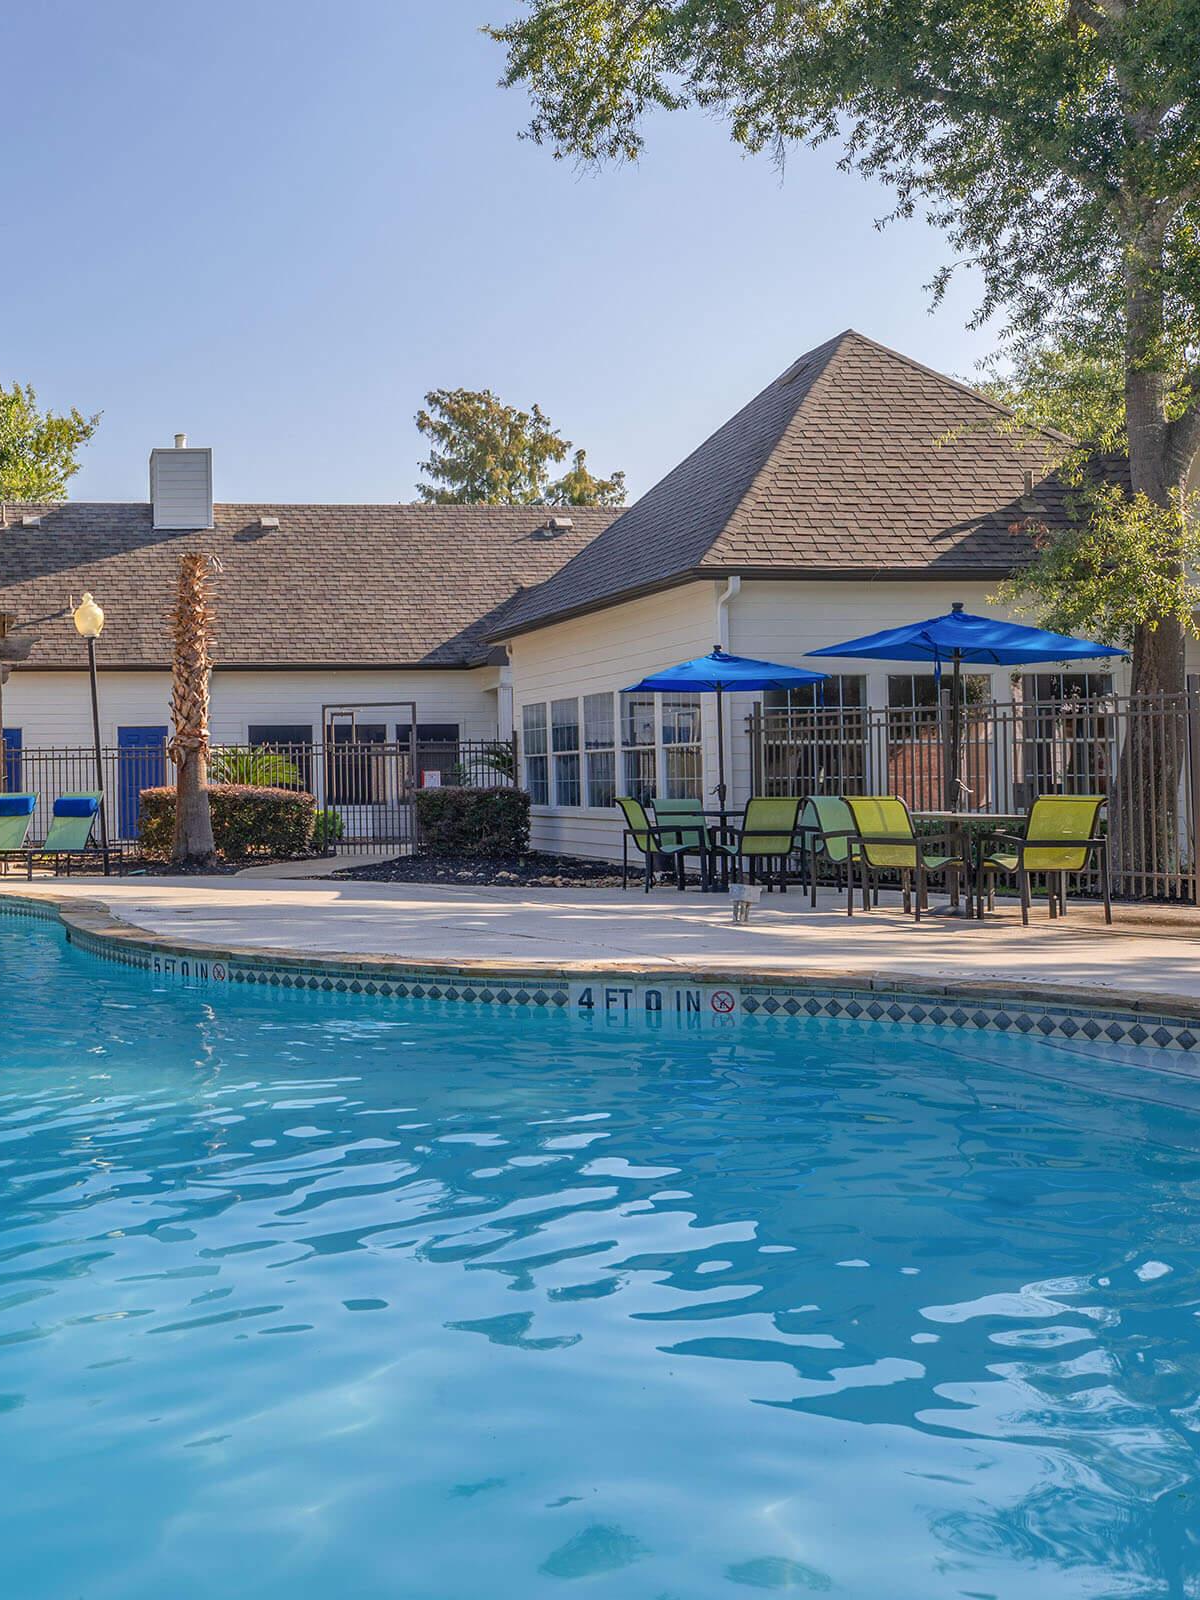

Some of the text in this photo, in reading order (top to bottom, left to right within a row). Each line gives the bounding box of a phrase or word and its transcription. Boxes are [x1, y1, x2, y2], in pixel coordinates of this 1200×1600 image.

[154, 957, 161, 973] 5
[164, 958, 176, 976] FT
[195, 962, 208, 979] IN
[578, 987, 594, 1009] 4
[606, 988, 633, 1010] FT
[676, 990, 701, 1012] IN
